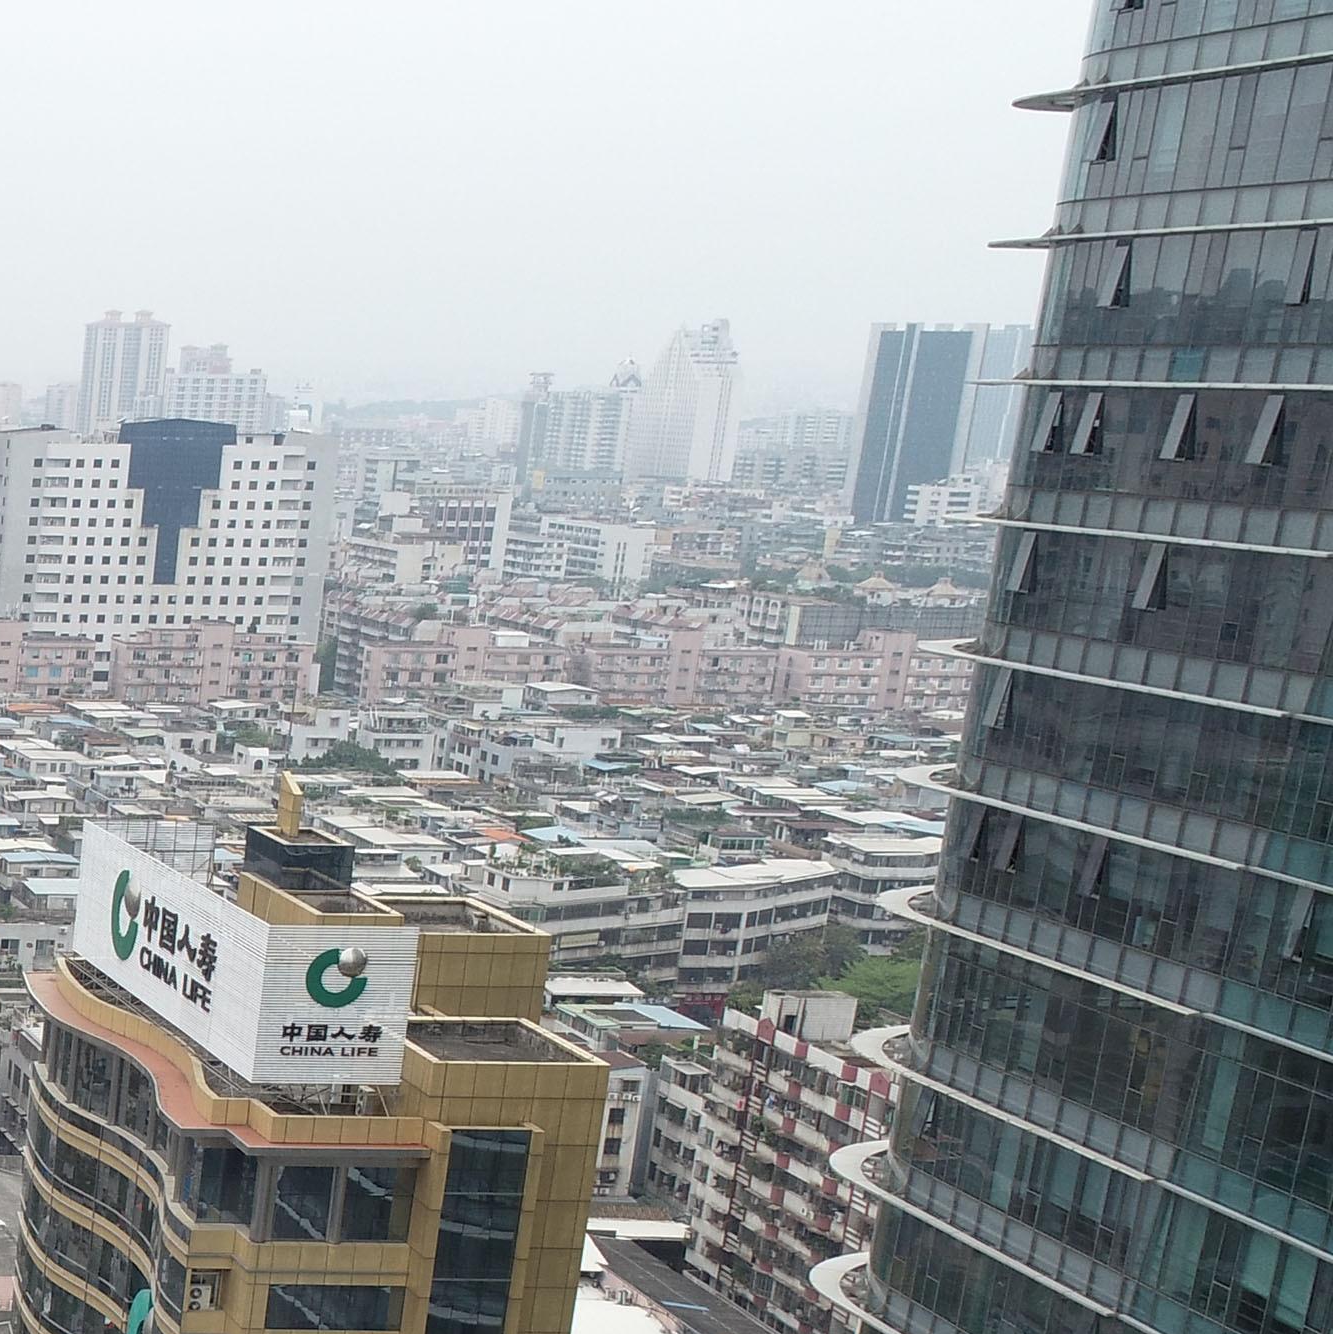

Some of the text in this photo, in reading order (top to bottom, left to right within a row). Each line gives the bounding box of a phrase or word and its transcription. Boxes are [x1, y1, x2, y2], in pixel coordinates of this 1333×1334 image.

[144, 897, 217, 983] 中国人寿
[139, 949, 212, 1013] CHINA LIFE
[280, 1046, 379, 1057] CHINA LIFE
[281, 1023, 383, 1042] 中国人寿
